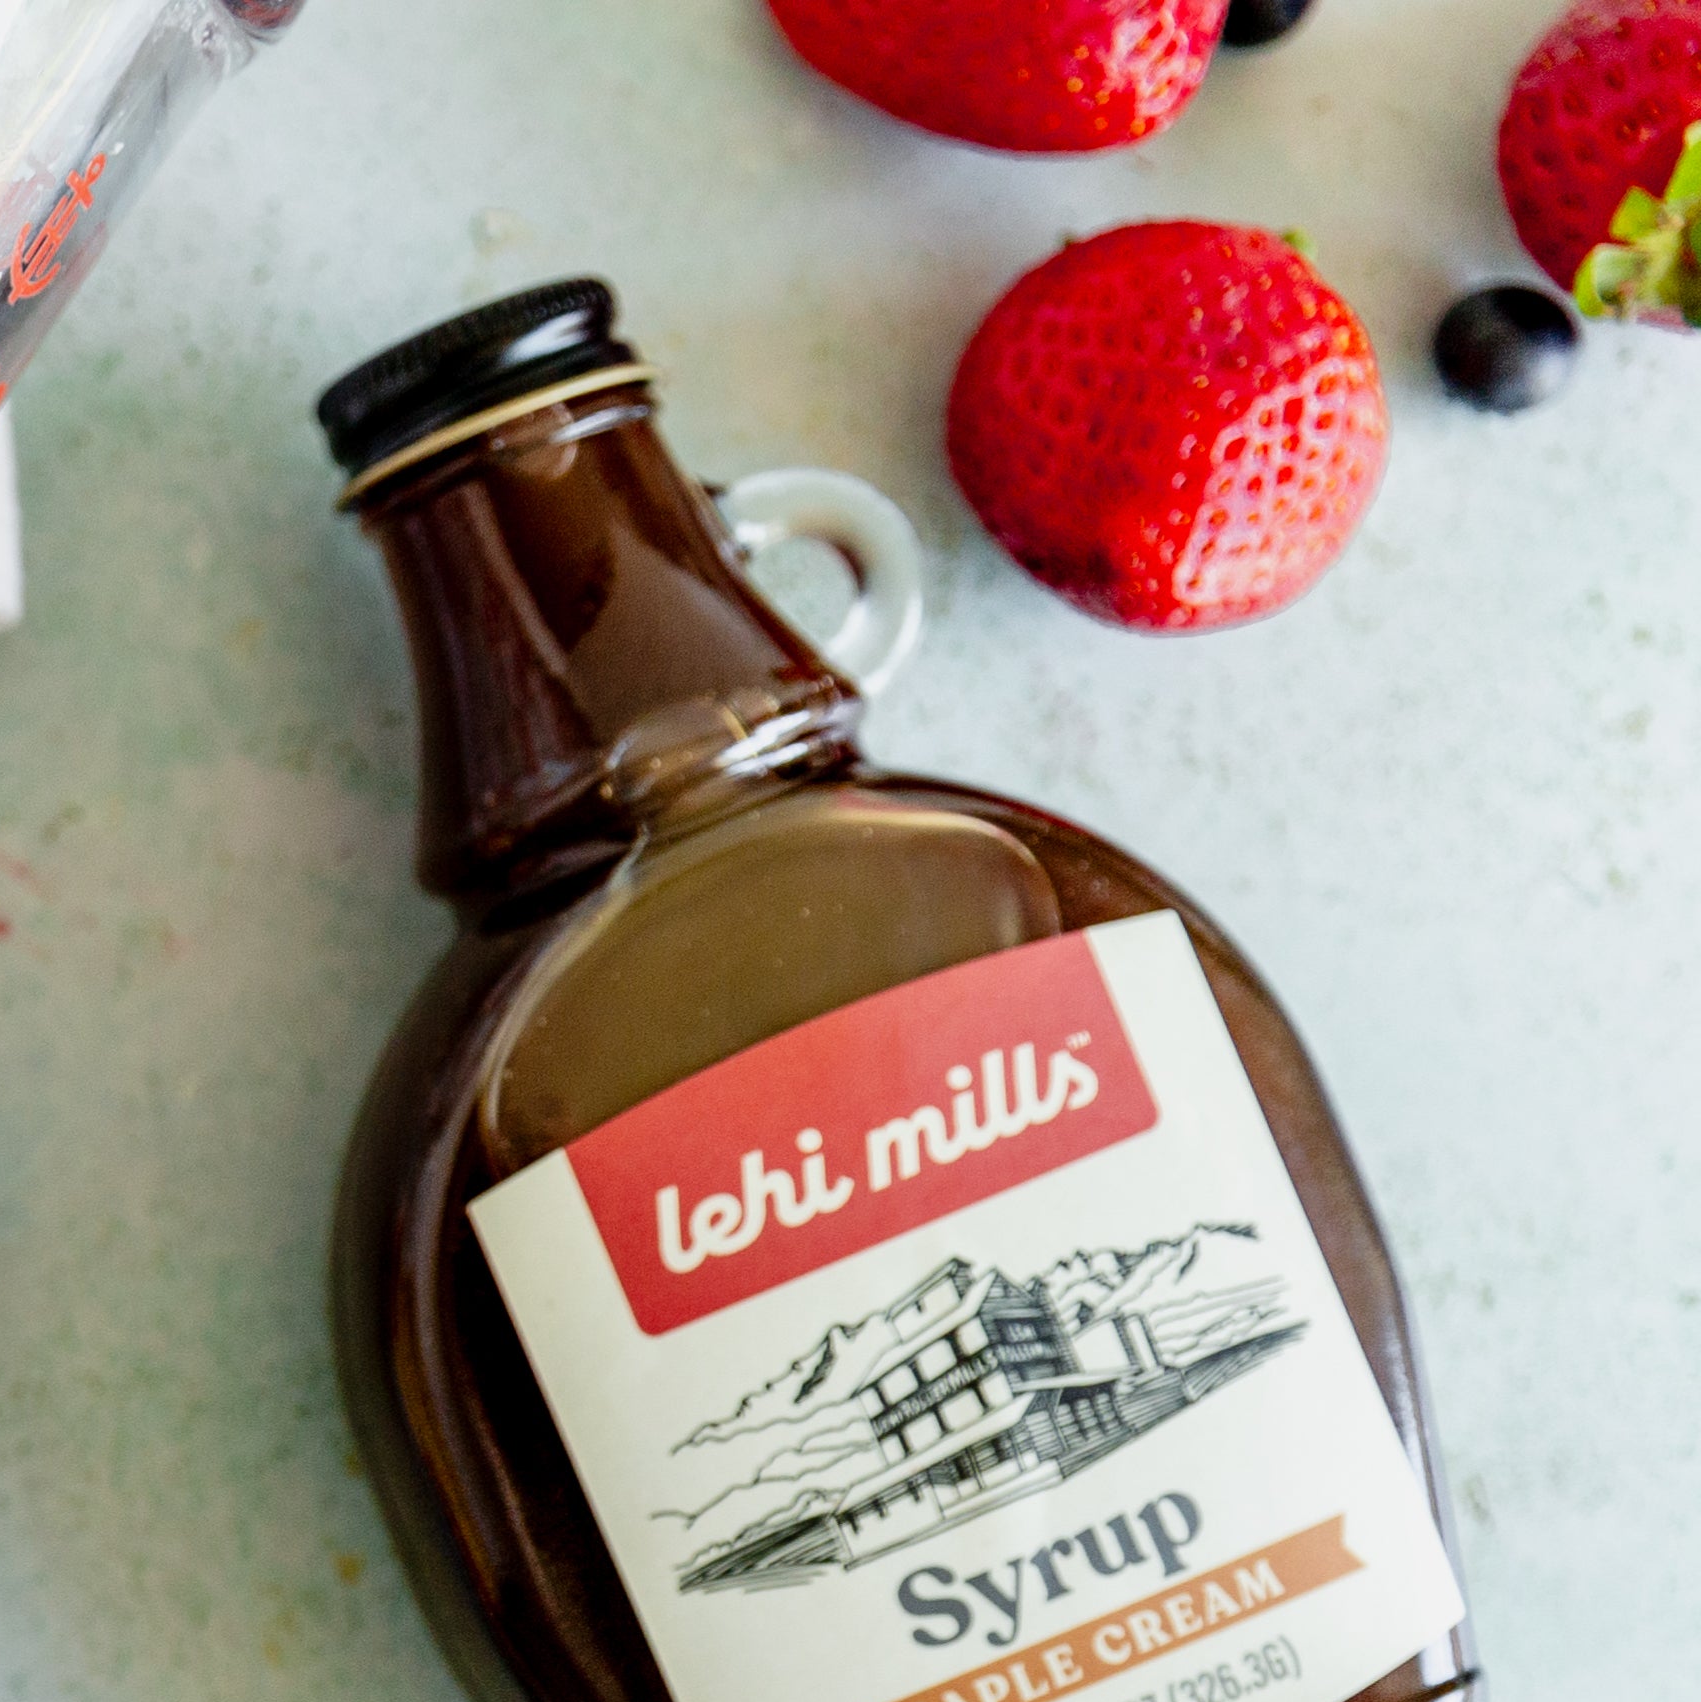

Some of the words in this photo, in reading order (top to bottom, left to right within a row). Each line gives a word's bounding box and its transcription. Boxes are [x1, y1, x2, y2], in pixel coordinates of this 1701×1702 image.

[655, 1126, 856, 1275] lehi
[865, 1040, 1100, 1193] mills
[896, 1489, 1203, 1648] Syrup
[1094, 1558, 1287, 1666] CREAM
